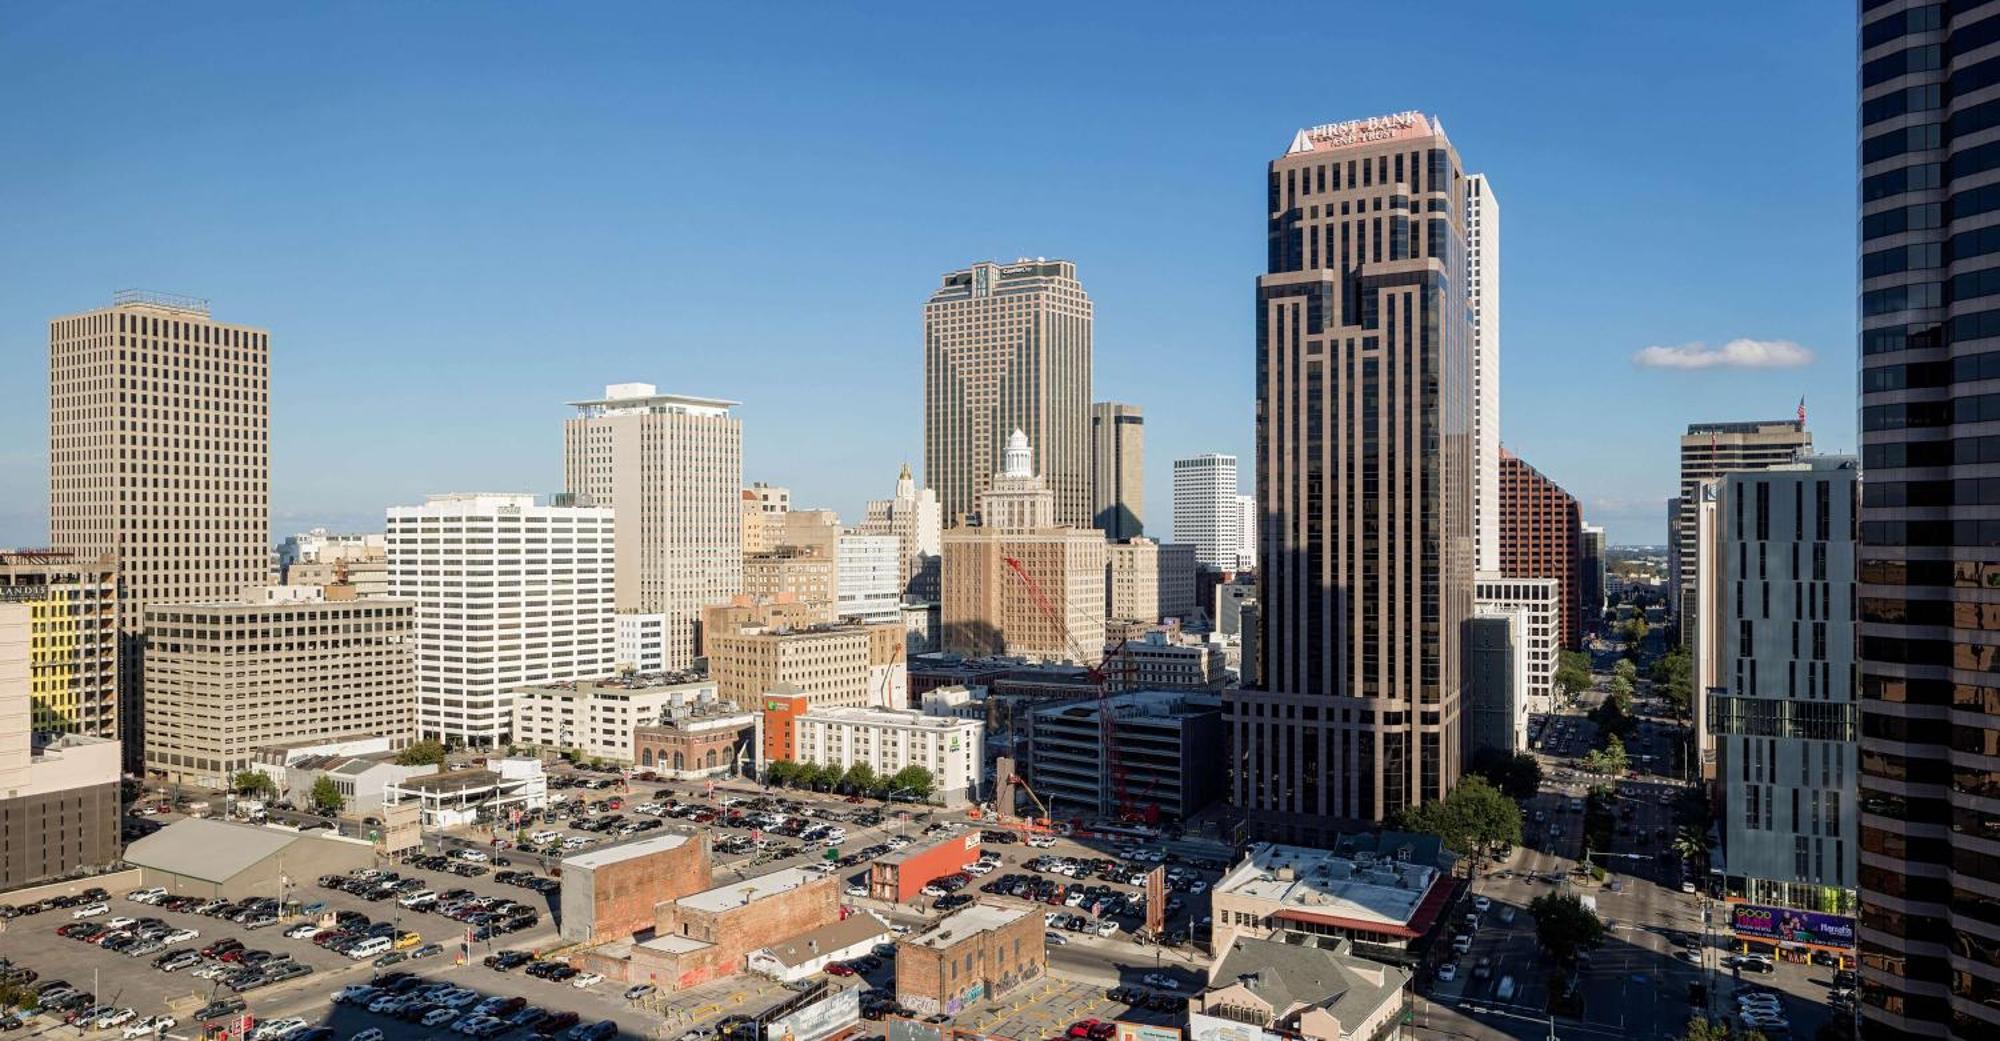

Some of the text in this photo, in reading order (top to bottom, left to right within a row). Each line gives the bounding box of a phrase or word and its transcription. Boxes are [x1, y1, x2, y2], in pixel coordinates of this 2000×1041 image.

[1312, 110, 1418, 138] FIRST BANK
[1736, 908, 1771, 920] GOOD
